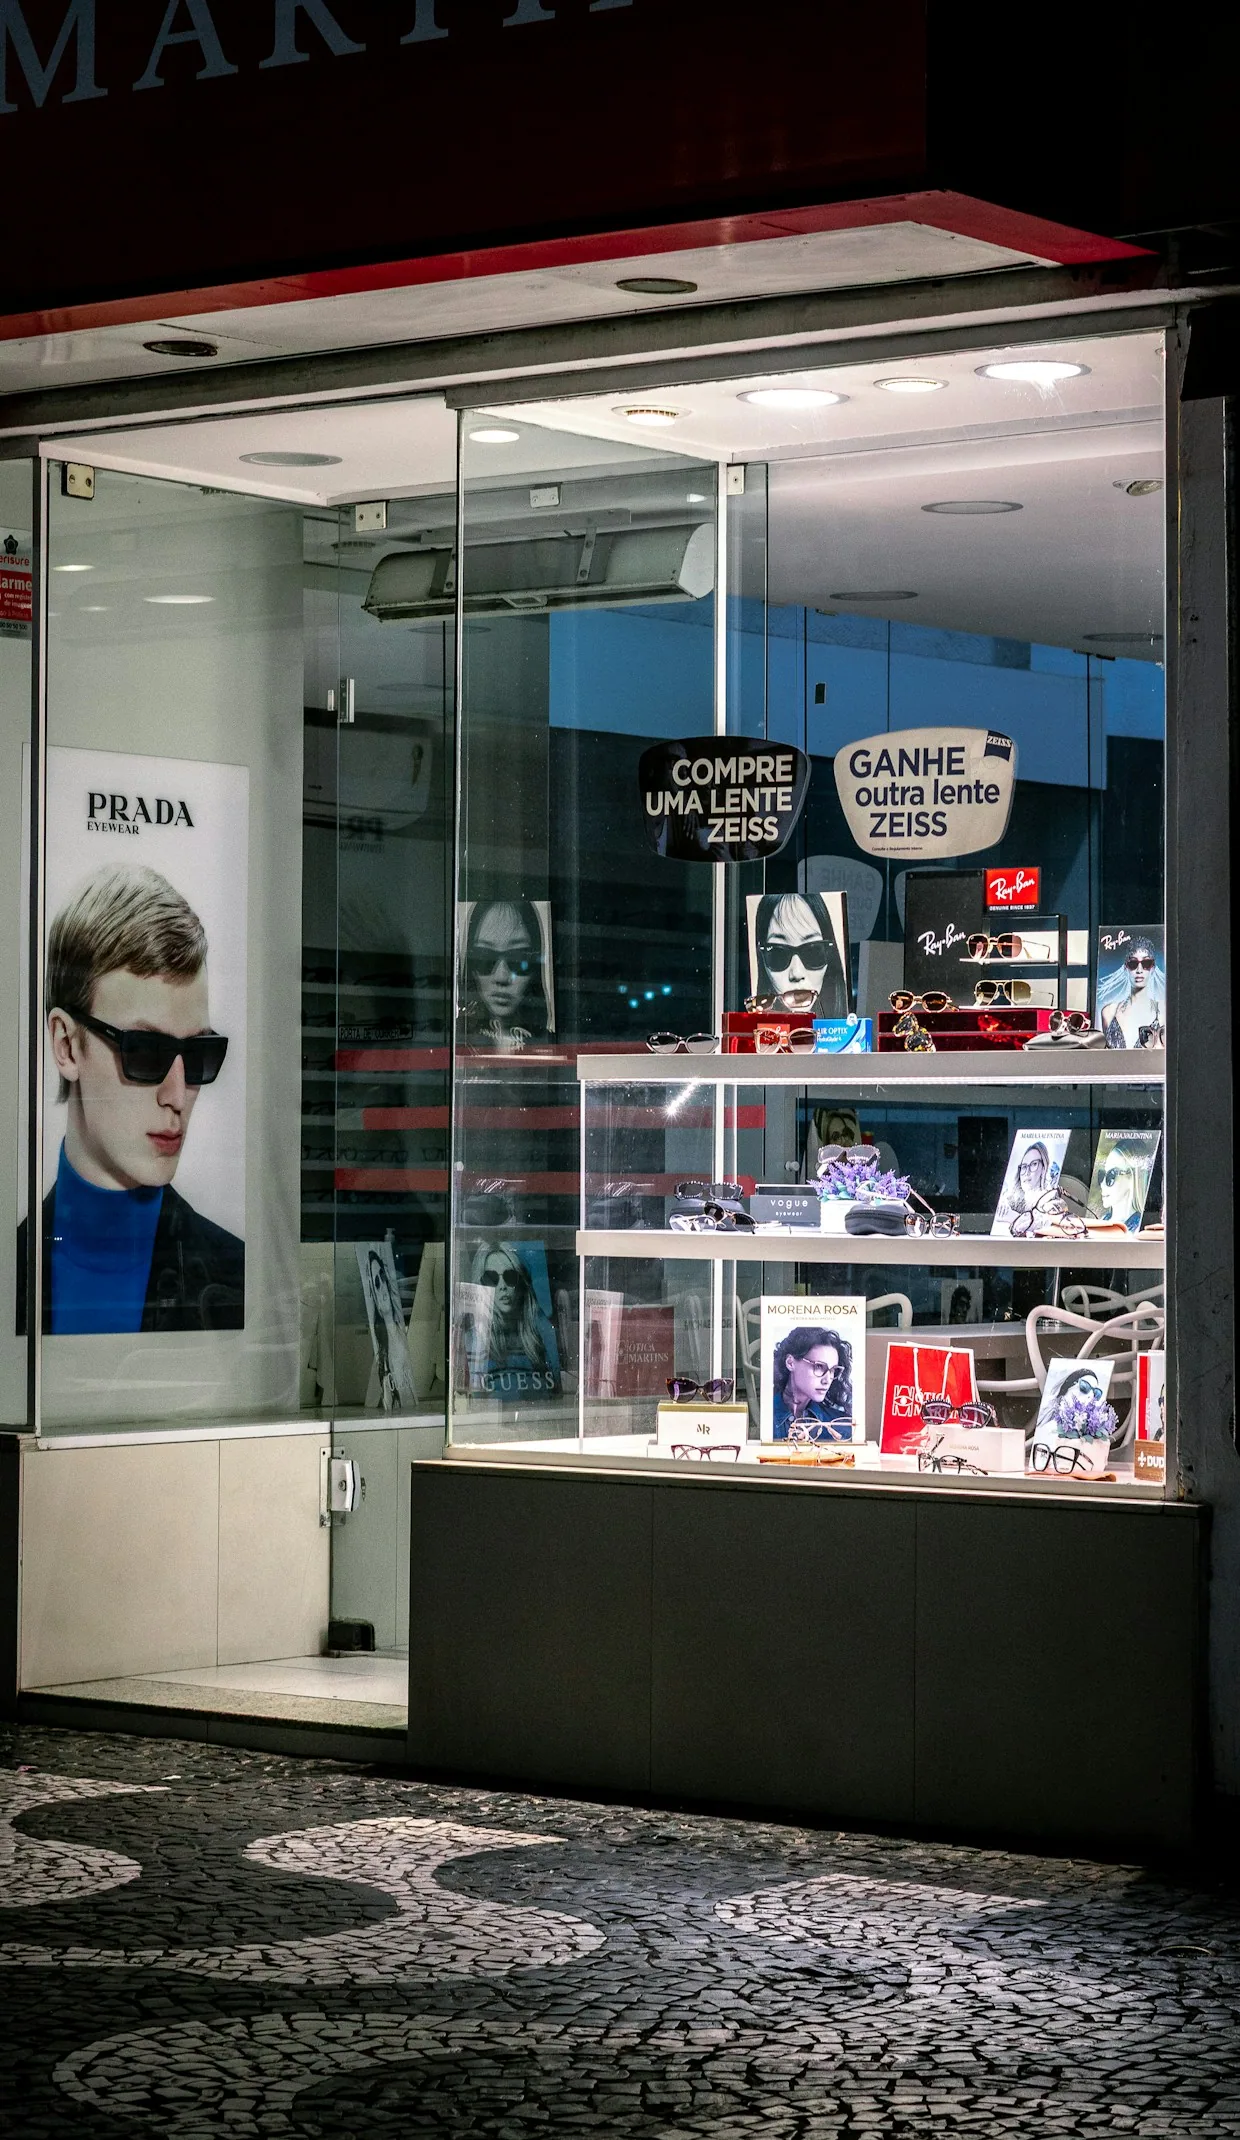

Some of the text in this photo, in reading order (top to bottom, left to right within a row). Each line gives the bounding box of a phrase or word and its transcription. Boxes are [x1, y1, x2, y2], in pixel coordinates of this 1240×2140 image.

[0, 577, 32, 592] arme
[987, 735, 1012, 748] ZEISS
[672, 754, 793, 787] COMPRE
[849, 746, 965, 778] GANHE
[646, 786, 792, 816] UMA LENTE
[855, 778, 1000, 807] outra lente
[88, 792, 195, 827] PRADA
[87, 821, 139, 835] EYEWEAR
[707, 816, 779, 843] ZEISS
[869, 811, 948, 838] ZEISS
[828, 1027, 848, 1036] OPTIX
[770, 1199, 808, 1209] vogue
[767, 1305, 858, 1315] MORENA ROSA
[629, 1353, 669, 1363] MARTINS
[481, 1371, 555, 1392] GUESS
